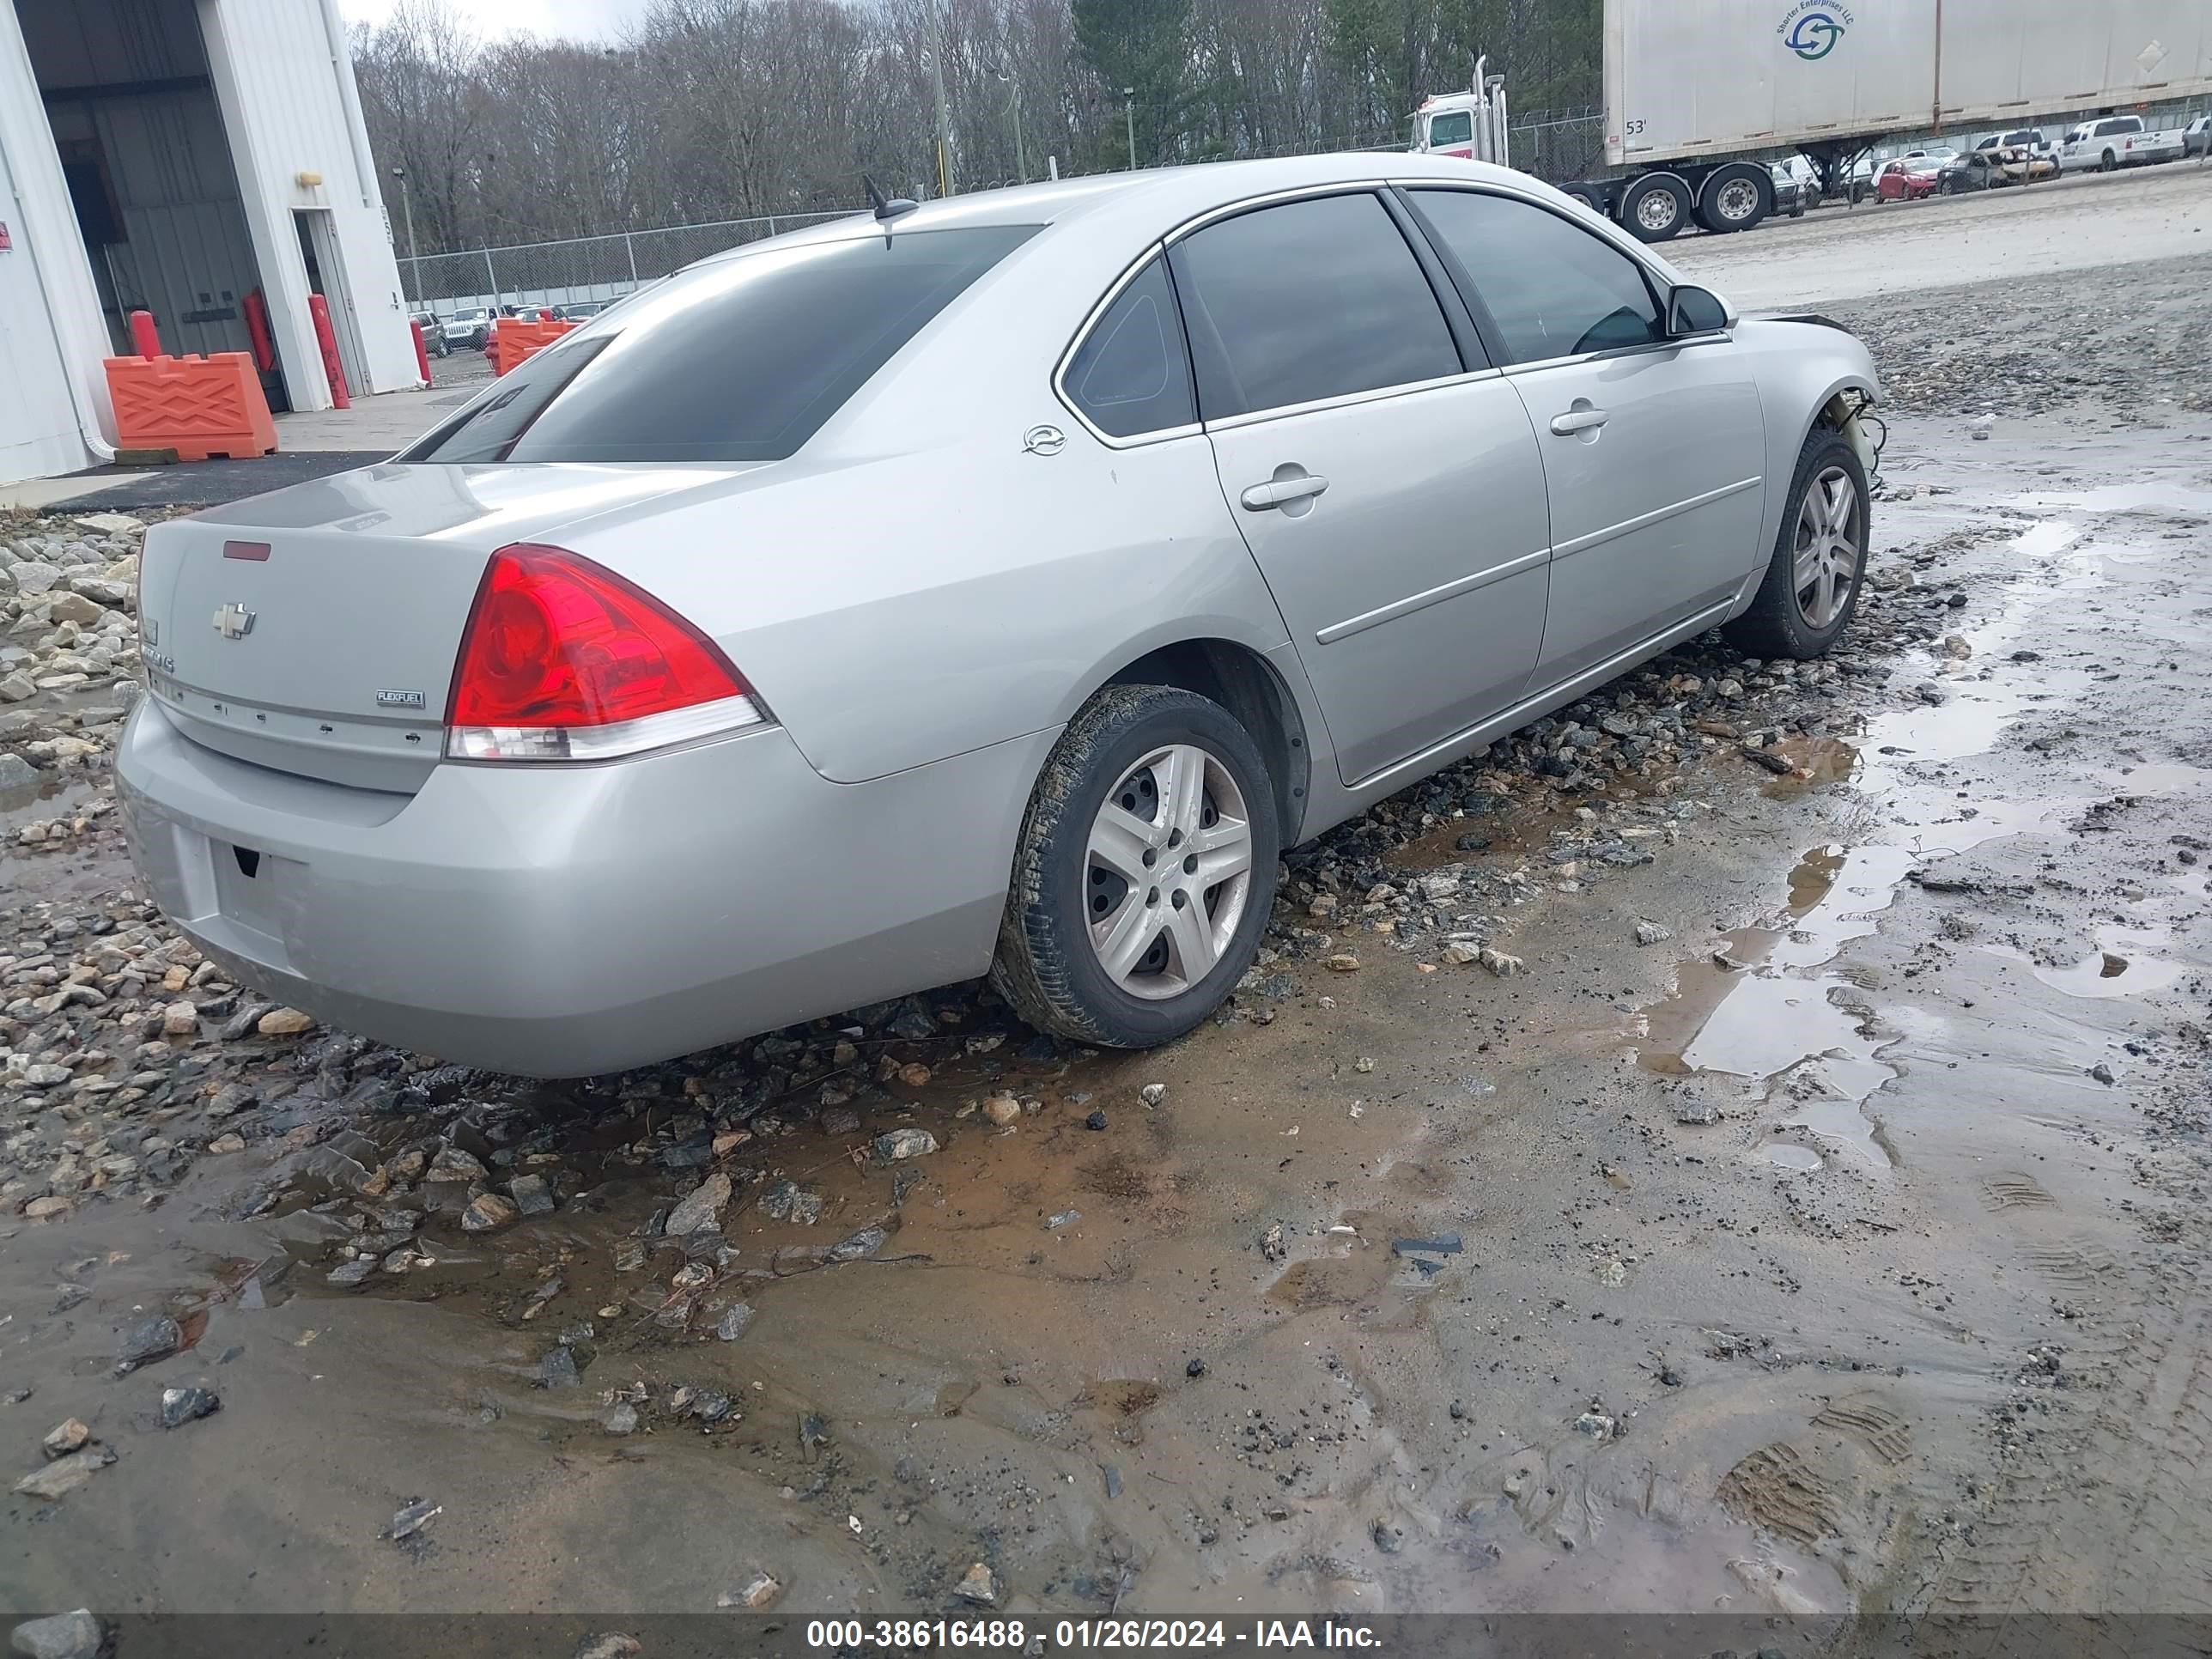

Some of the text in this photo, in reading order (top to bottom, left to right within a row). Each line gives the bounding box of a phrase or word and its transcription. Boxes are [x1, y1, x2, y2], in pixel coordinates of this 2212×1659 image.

[1777, 0, 1855, 34] Shorter Enterprises LLC
[378, 691, 420, 702] FLEXFUEL
